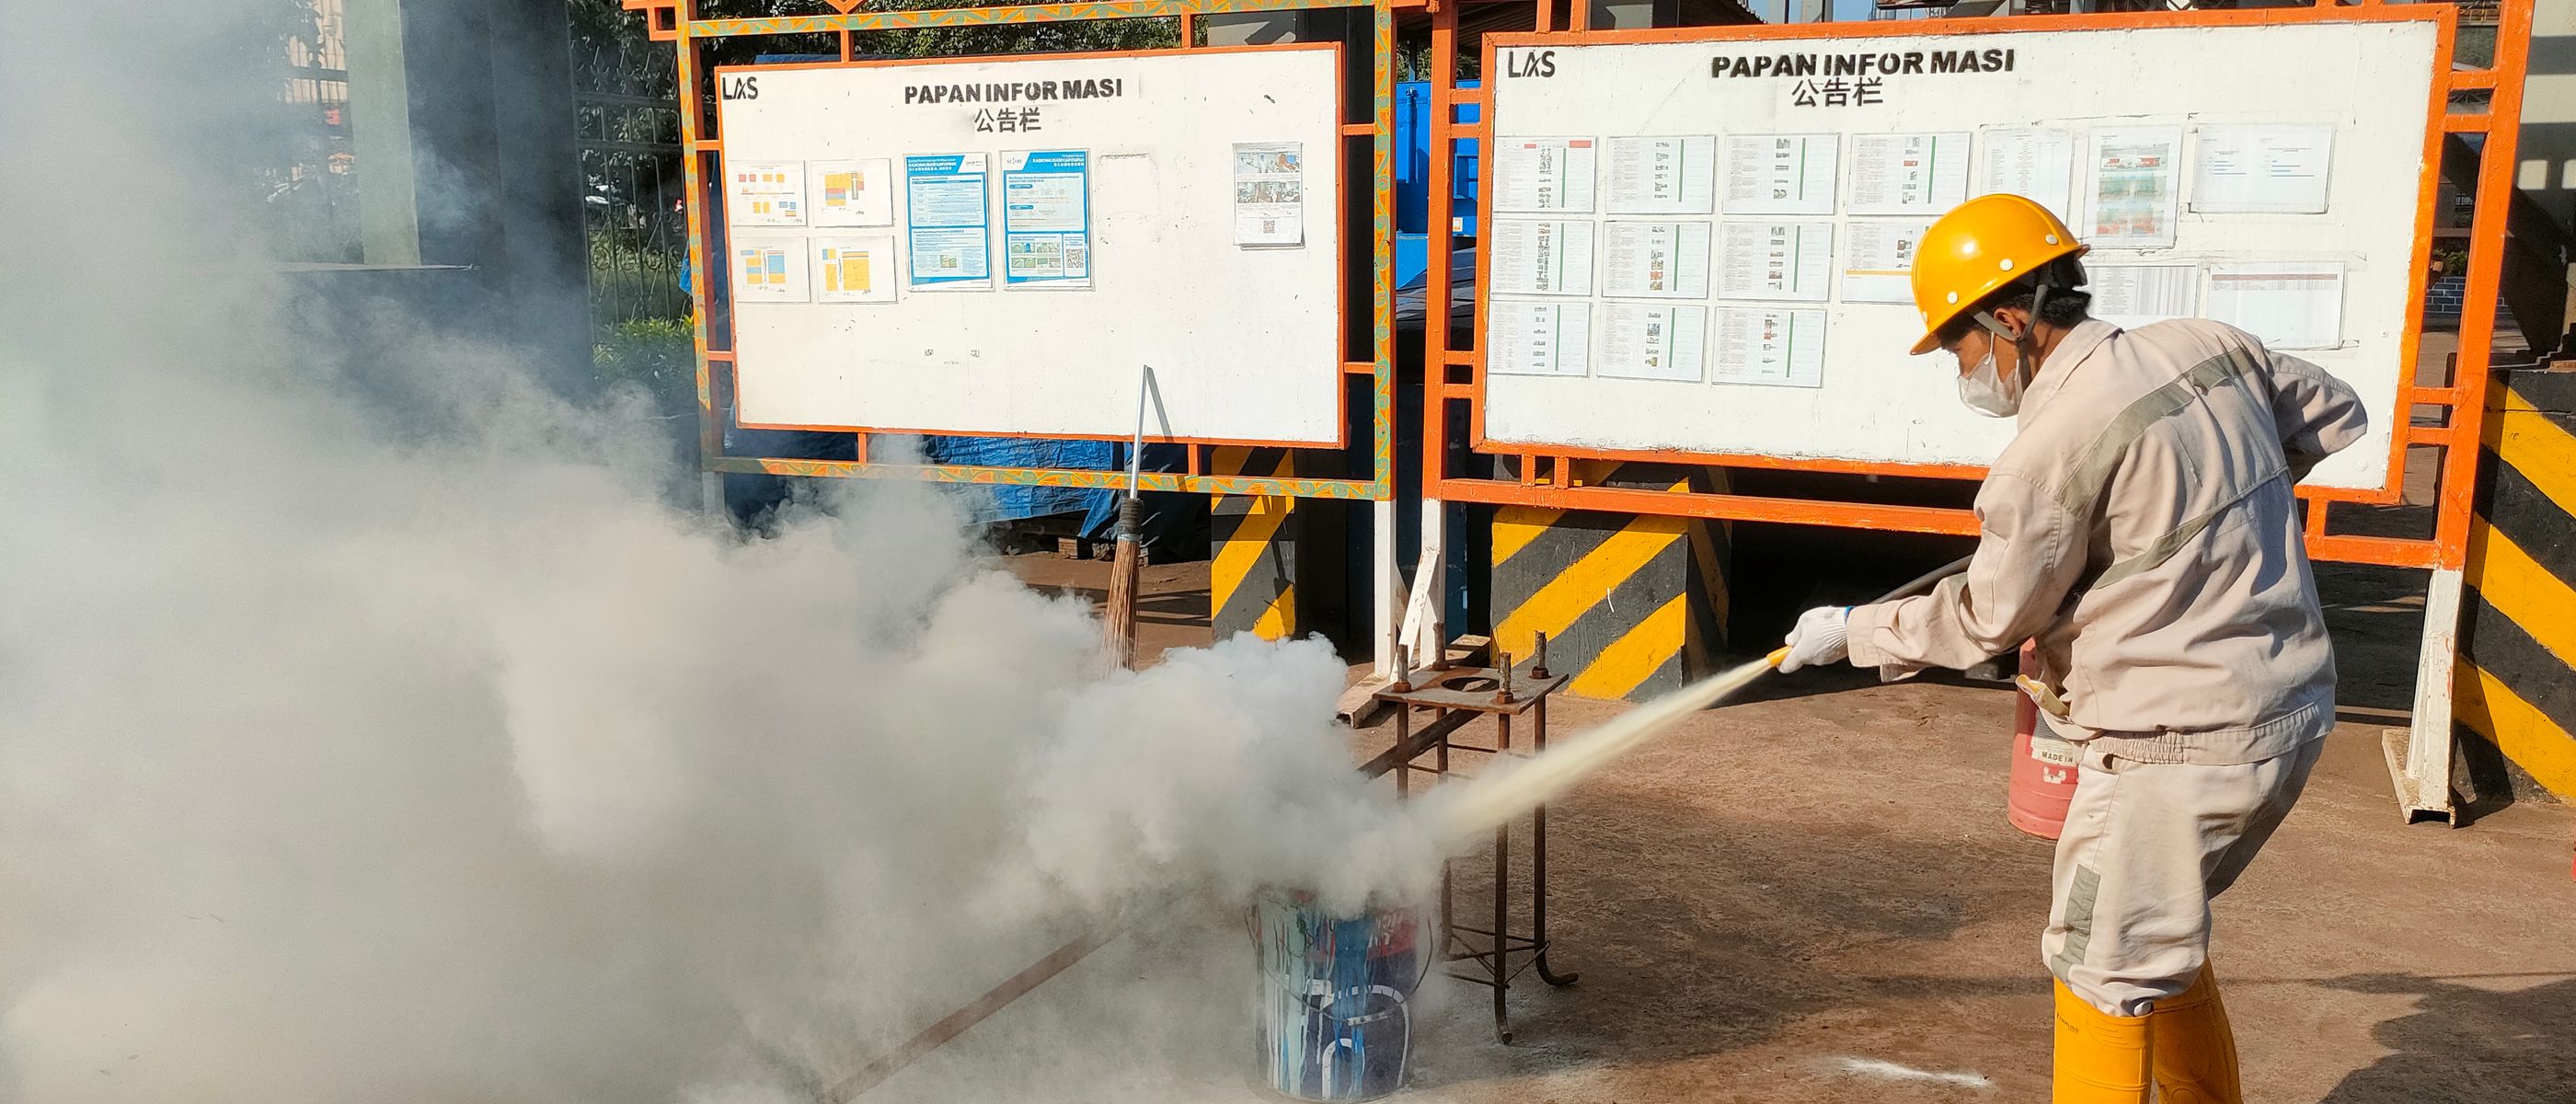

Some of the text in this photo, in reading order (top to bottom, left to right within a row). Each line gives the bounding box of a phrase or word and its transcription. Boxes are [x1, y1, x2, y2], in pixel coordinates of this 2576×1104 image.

[1711, 52, 1817, 78] PAPAN
[904, 84, 981, 104] PAPAN
[1790, 75, 1883, 107] 公告栏
[973, 107, 1041, 132] 公告栏
[2041, 751, 2064, 763] MADE
